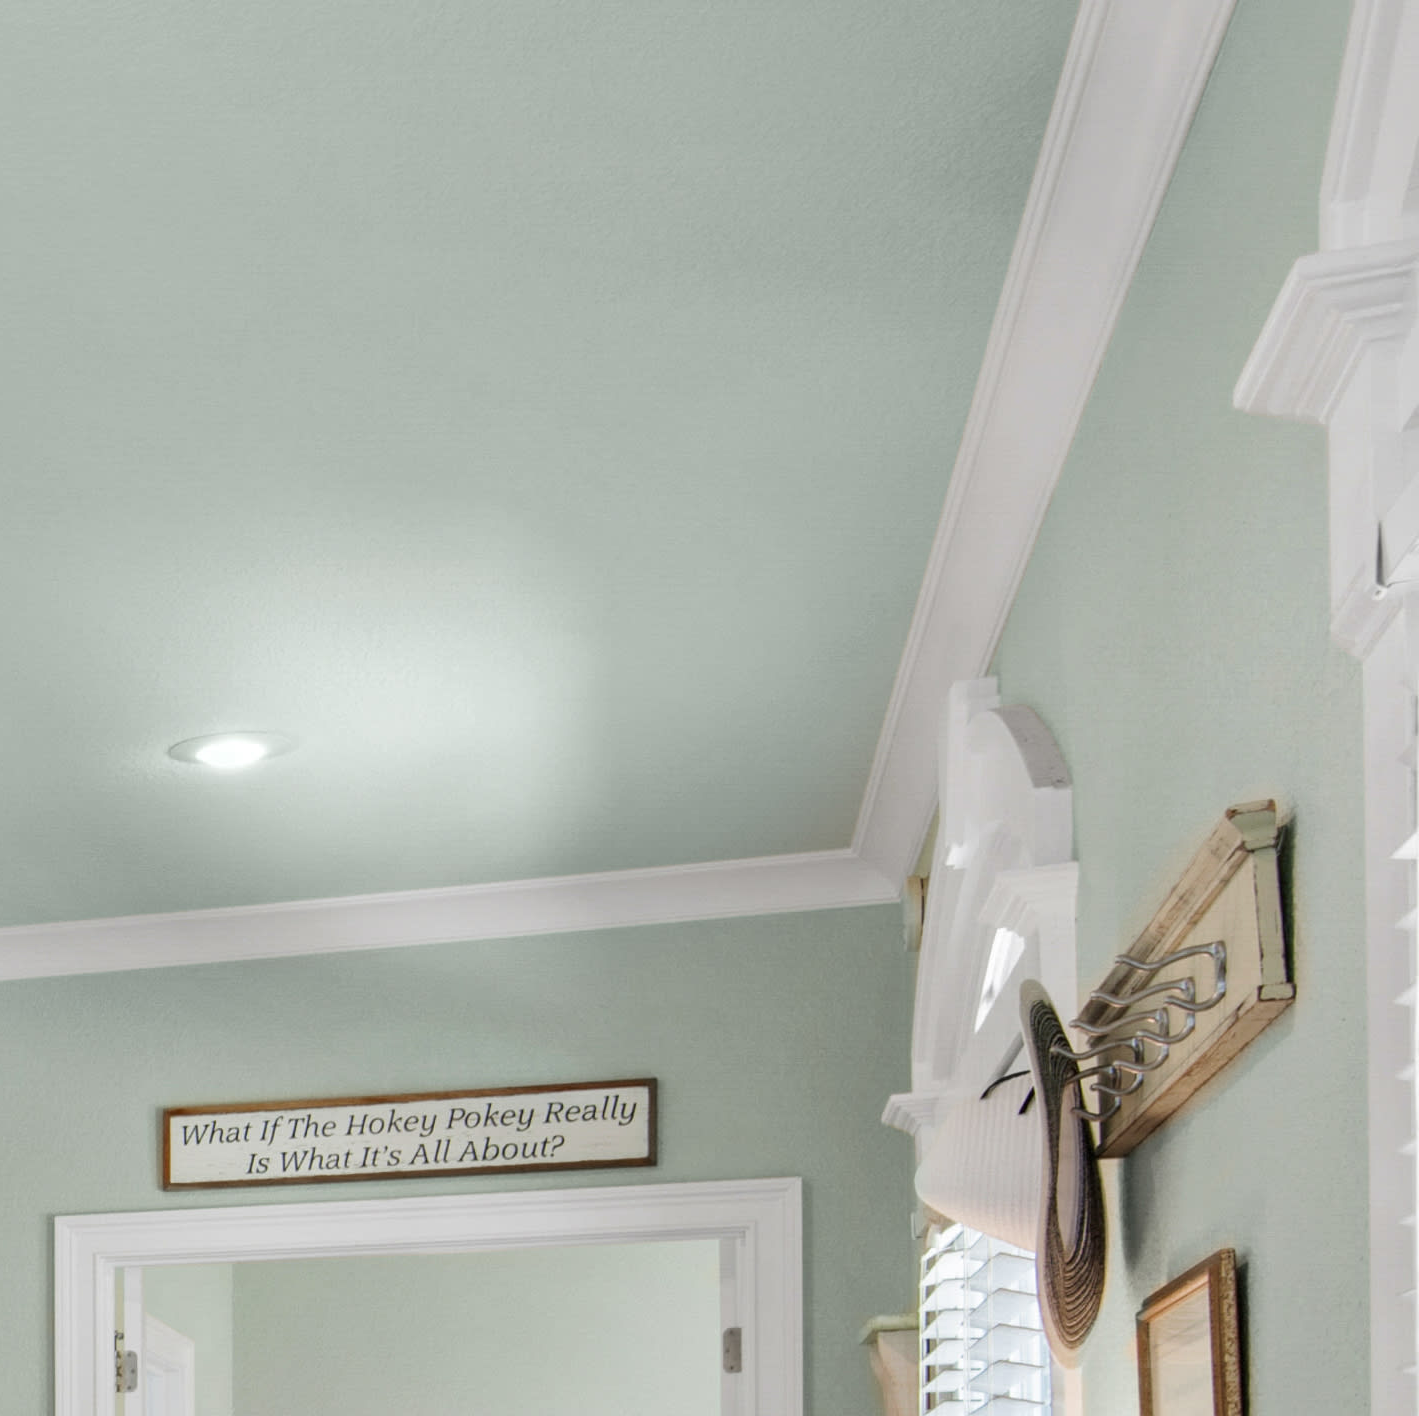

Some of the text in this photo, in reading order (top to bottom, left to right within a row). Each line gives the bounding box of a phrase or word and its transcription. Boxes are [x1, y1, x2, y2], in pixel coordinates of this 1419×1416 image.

[181, 1094, 638, 1146] What If The Hokey Pokey Really
[246, 1135, 565, 1175] Is What It's All About?
